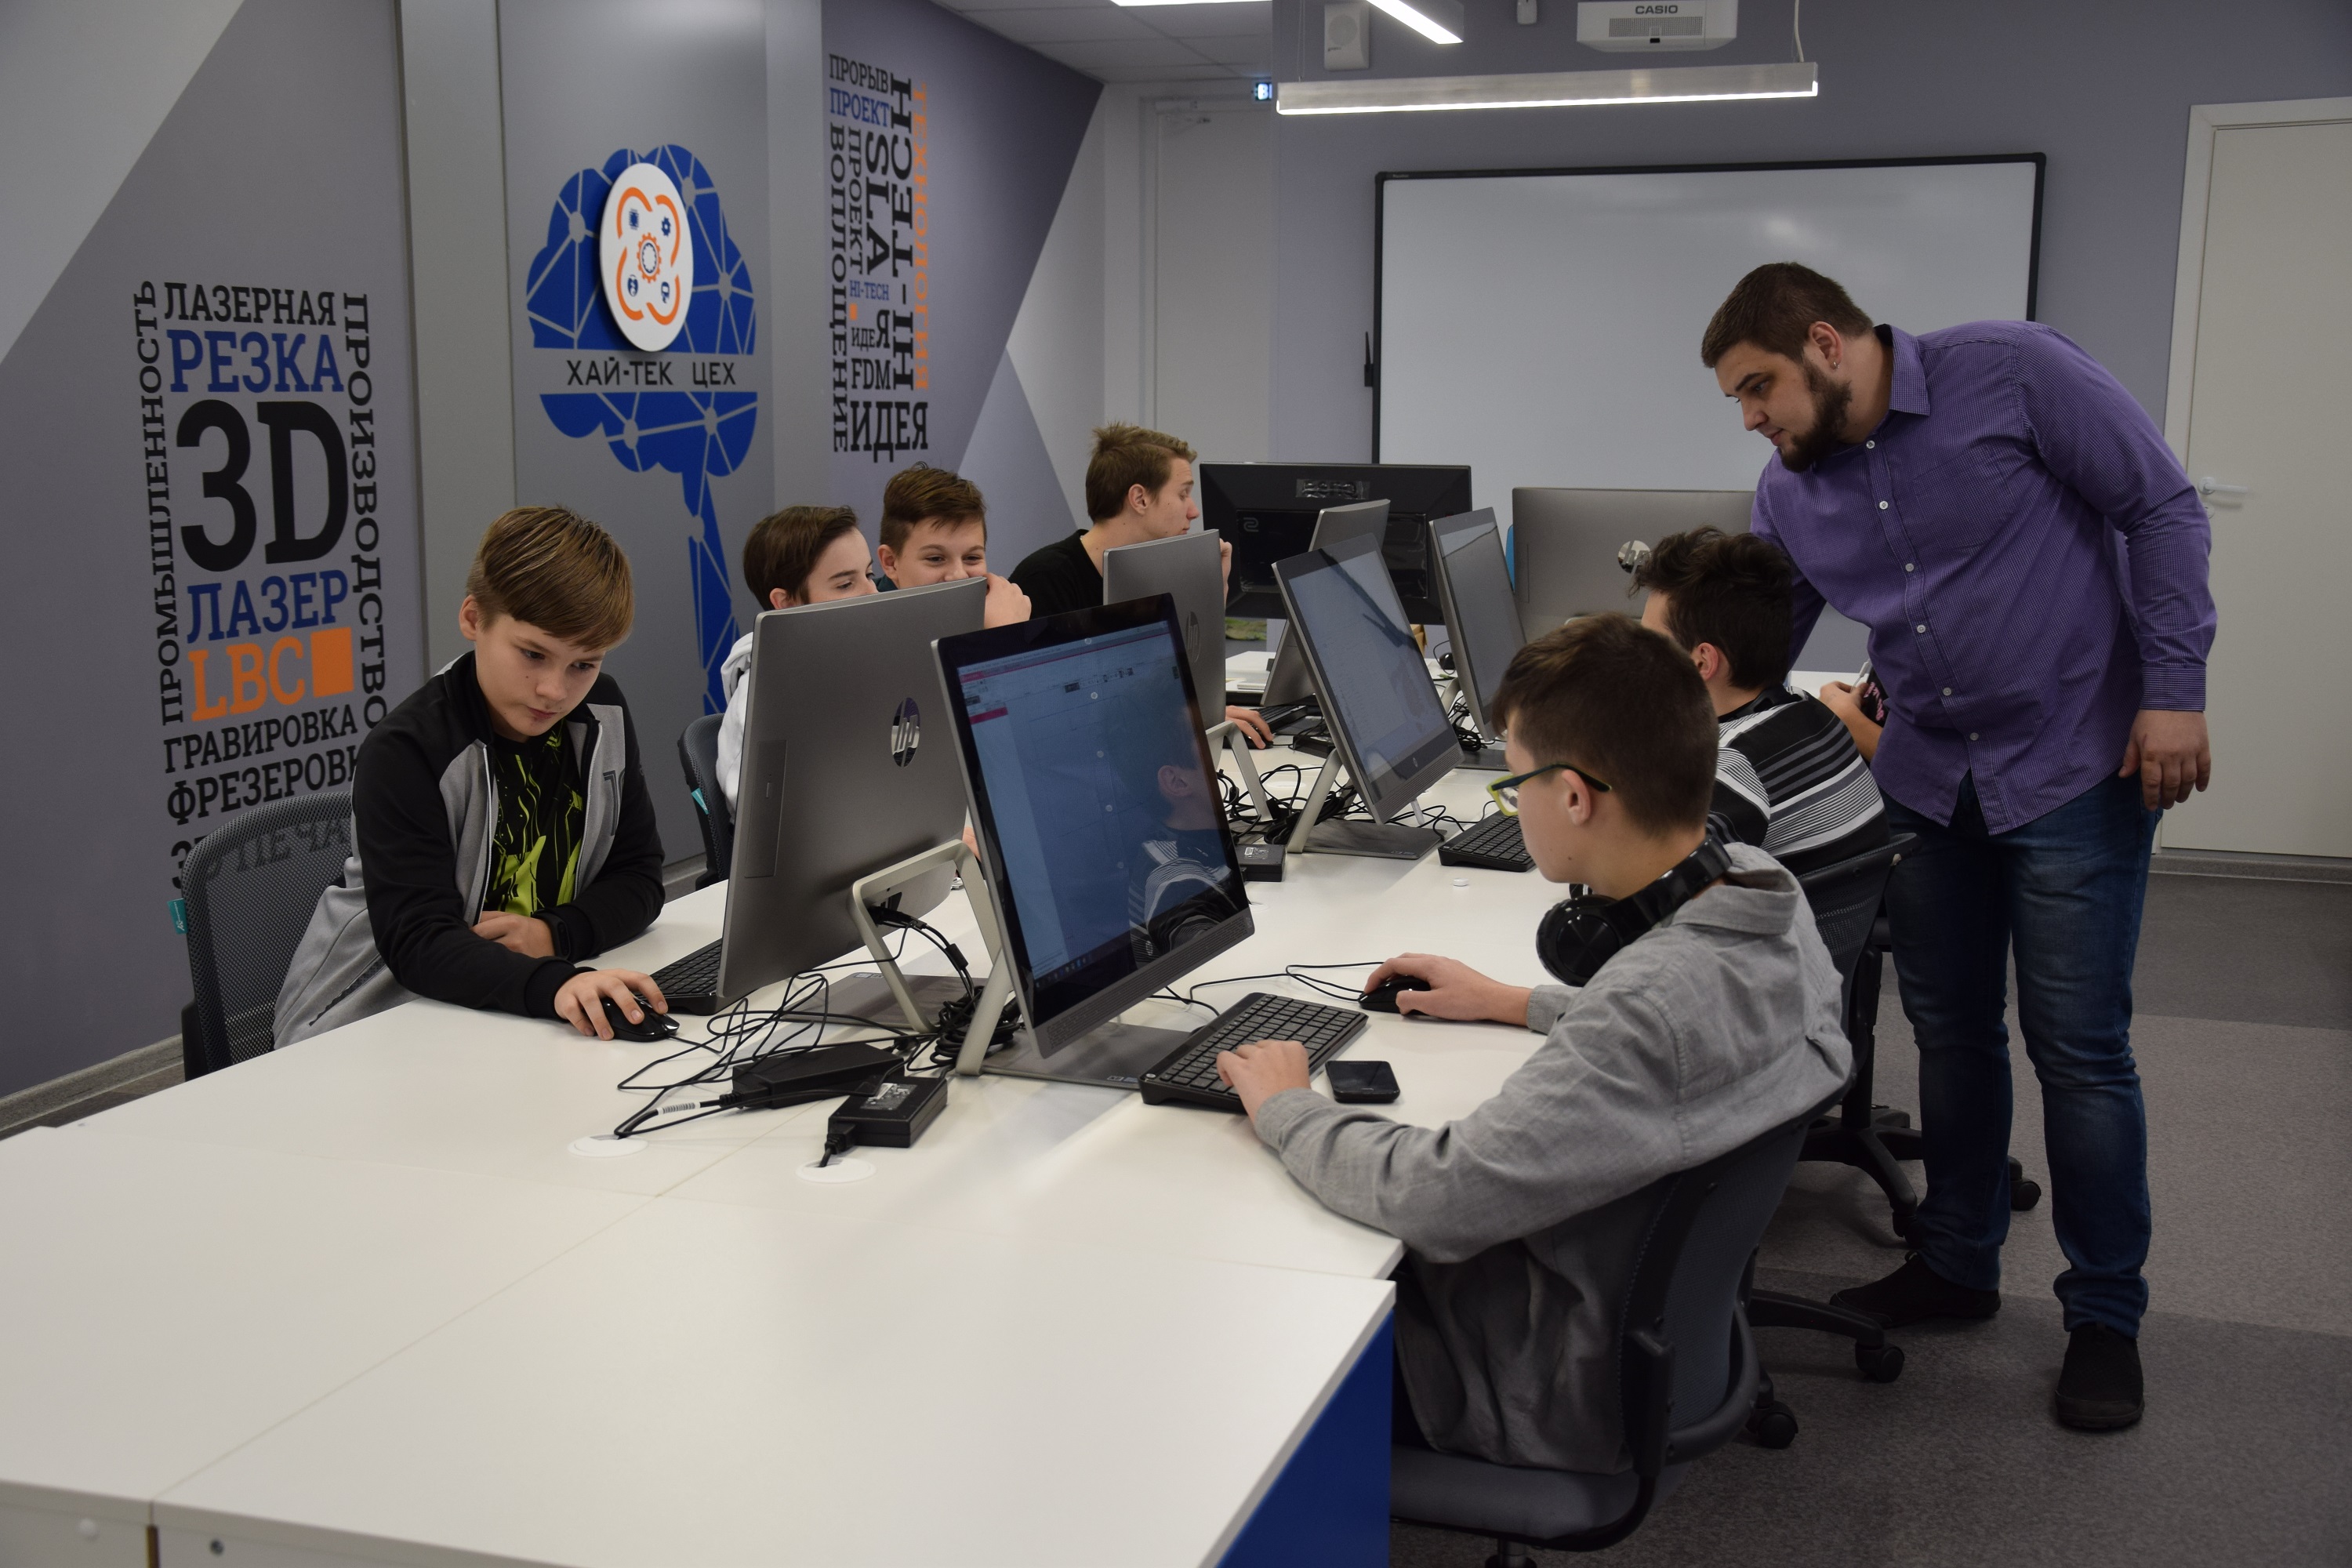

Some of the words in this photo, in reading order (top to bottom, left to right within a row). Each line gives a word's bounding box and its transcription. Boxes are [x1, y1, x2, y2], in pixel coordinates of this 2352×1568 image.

[1635, 5, 1679, 14] CASIO
[829, 55, 889, 93] ПРОРЫВ
[829, 87, 890, 128] ПРОЕКТ
[848, 126, 862, 274] ПРОЕКТ
[865, 132, 890, 275] SLA
[891, 73, 913, 390] HI-TECH
[913, 82, 928, 391] ТЕХНОЛОГИЯ
[164, 281, 336, 325] ЛАЗЕРНАЯ
[829, 122, 848, 452] ВОПЛОЩЕНИЕ
[849, 279, 890, 301] HI-TECH
[166, 329, 343, 393] РЕЗКА
[851, 309, 891, 352] ИДЕЯ
[566, 357, 673, 386] ХАЙ-ТЕК
[691, 361, 736, 389] ЦЕХ
[851, 358, 891, 390] FDM
[850, 401, 929, 463] ИДЕЯ
[132, 281, 183, 726] ПРОМЫШЛЕННОСТЬ
[176, 399, 350, 572] 3D
[343, 292, 387, 729] ПРОИЗВОДСТВО
[187, 568, 350, 644] ЛАЗЕР
[187, 636, 306, 721] LBC
[163, 704, 358, 774] ГРАВИРОВКА
[891, 698, 920, 767] hp
